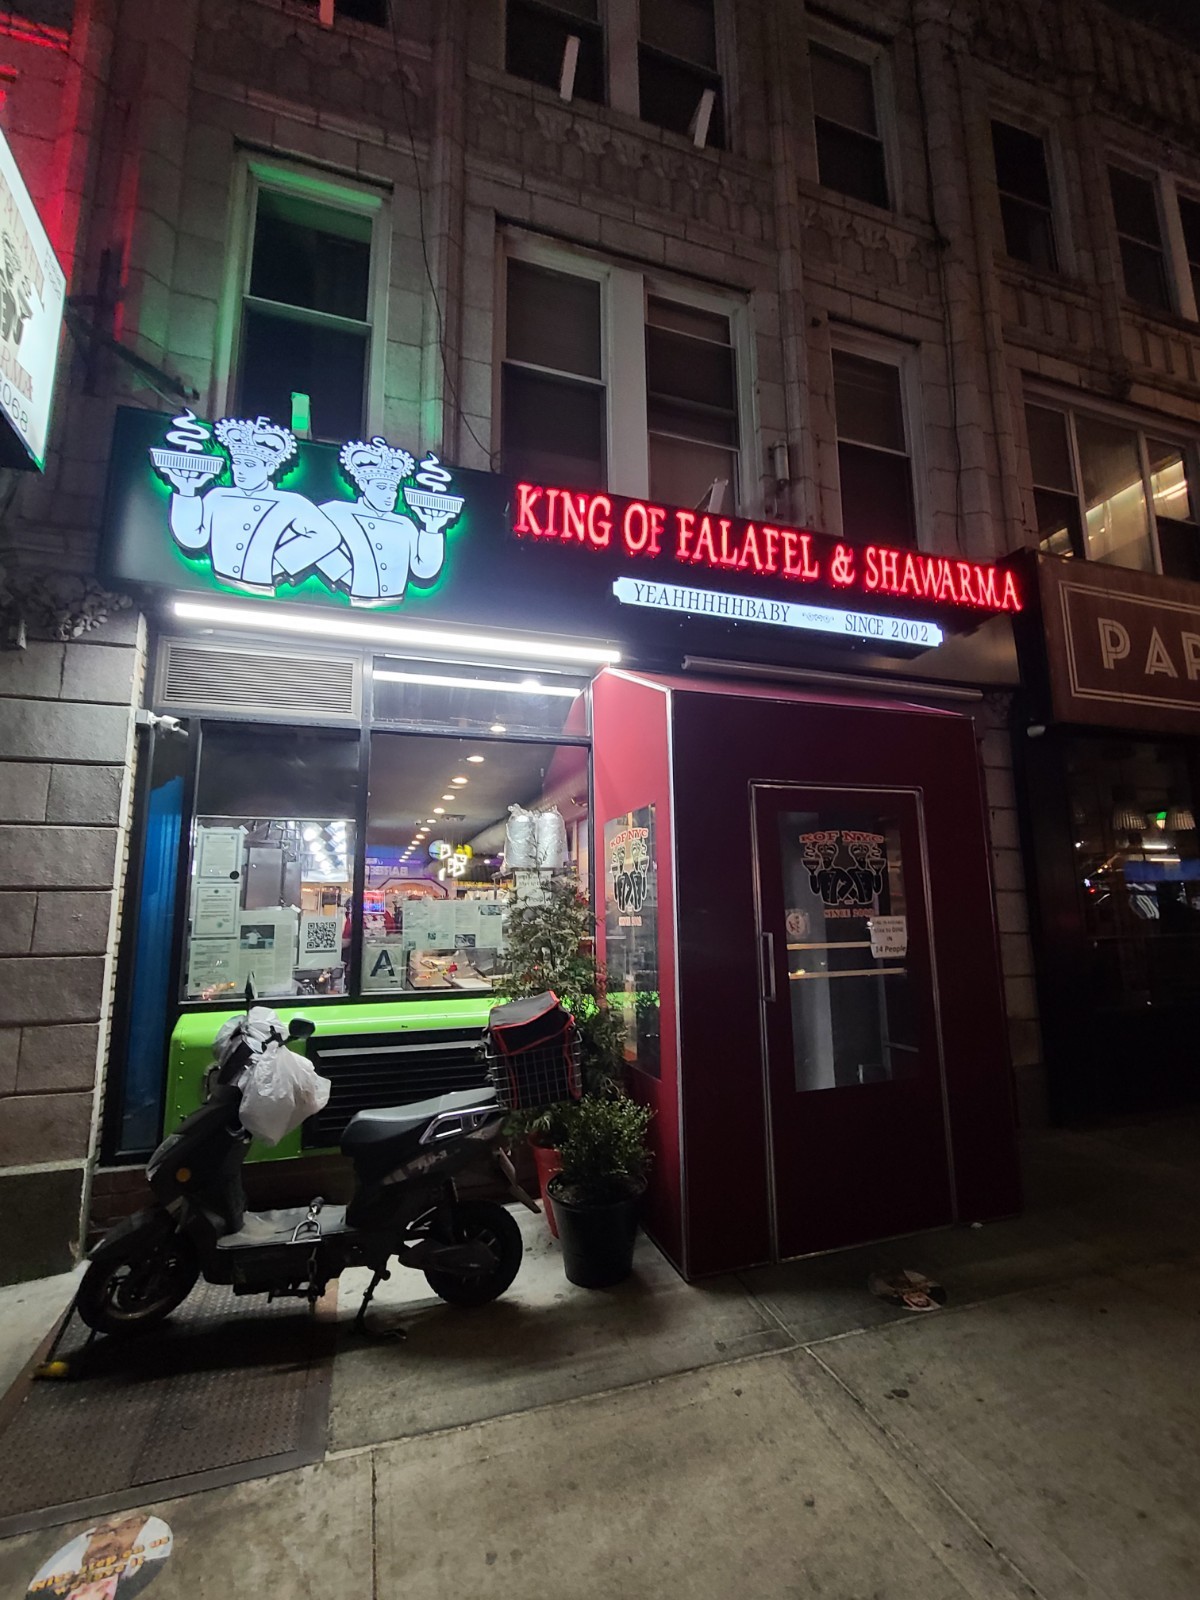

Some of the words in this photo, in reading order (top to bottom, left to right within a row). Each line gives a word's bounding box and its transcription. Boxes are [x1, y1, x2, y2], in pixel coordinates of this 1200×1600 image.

[514, 484, 612, 546] KING
[624, 503, 666, 553] OF
[676, 511, 819, 578] FALAFEL
[831, 544, 855, 584] &
[865, 546, 1021, 610] SHAWARMA
[634, 582, 790, 622] YEAHHHHHBABY
[844, 613, 884, 636] SINCE
[891, 620, 928, 642] 2002
[628, 828, 648, 840] NYC
[799, 831, 839, 843] KOF
[841, 831, 884, 843] NYC
[885, 944, 906, 954] People
[370, 950, 395, 976] A
